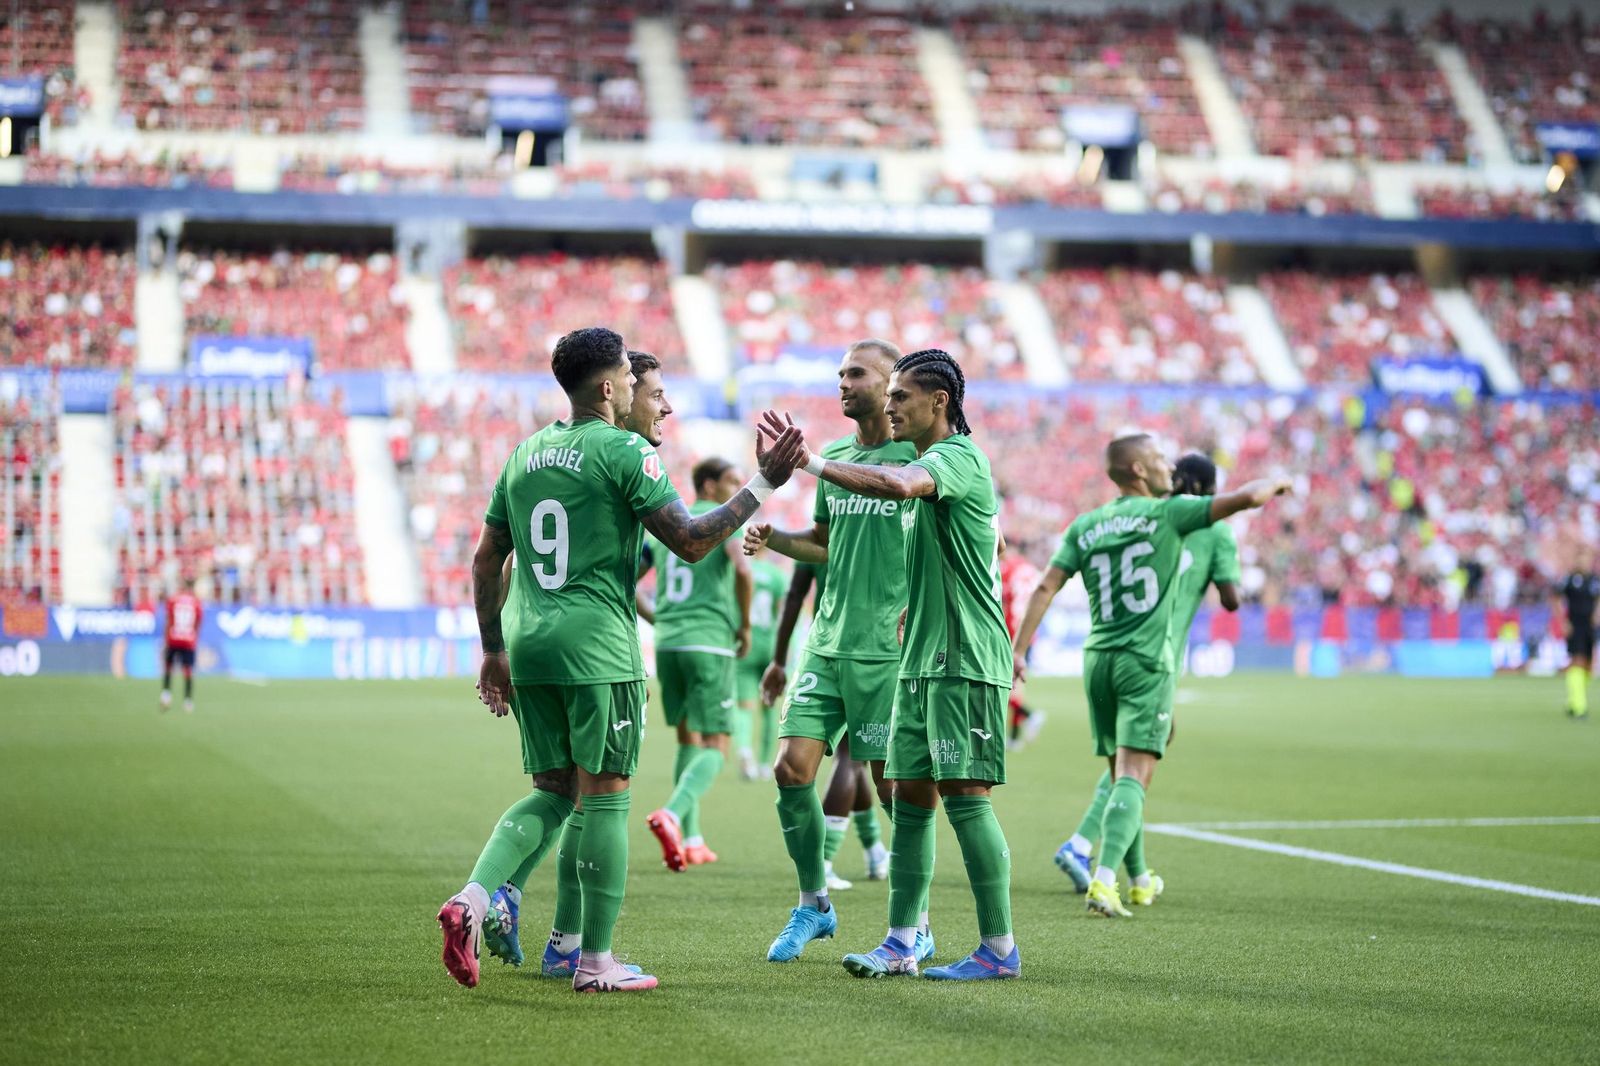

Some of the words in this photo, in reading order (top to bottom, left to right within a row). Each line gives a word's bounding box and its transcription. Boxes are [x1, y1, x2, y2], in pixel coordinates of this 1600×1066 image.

[526, 447, 585, 474] MIGUEL
[530, 498, 570, 590] 9
[665, 547, 694, 603] 6
[1090, 541, 1159, 622] 15
[861, 723, 890, 736] URBAN
[871, 735, 889, 748] POK
